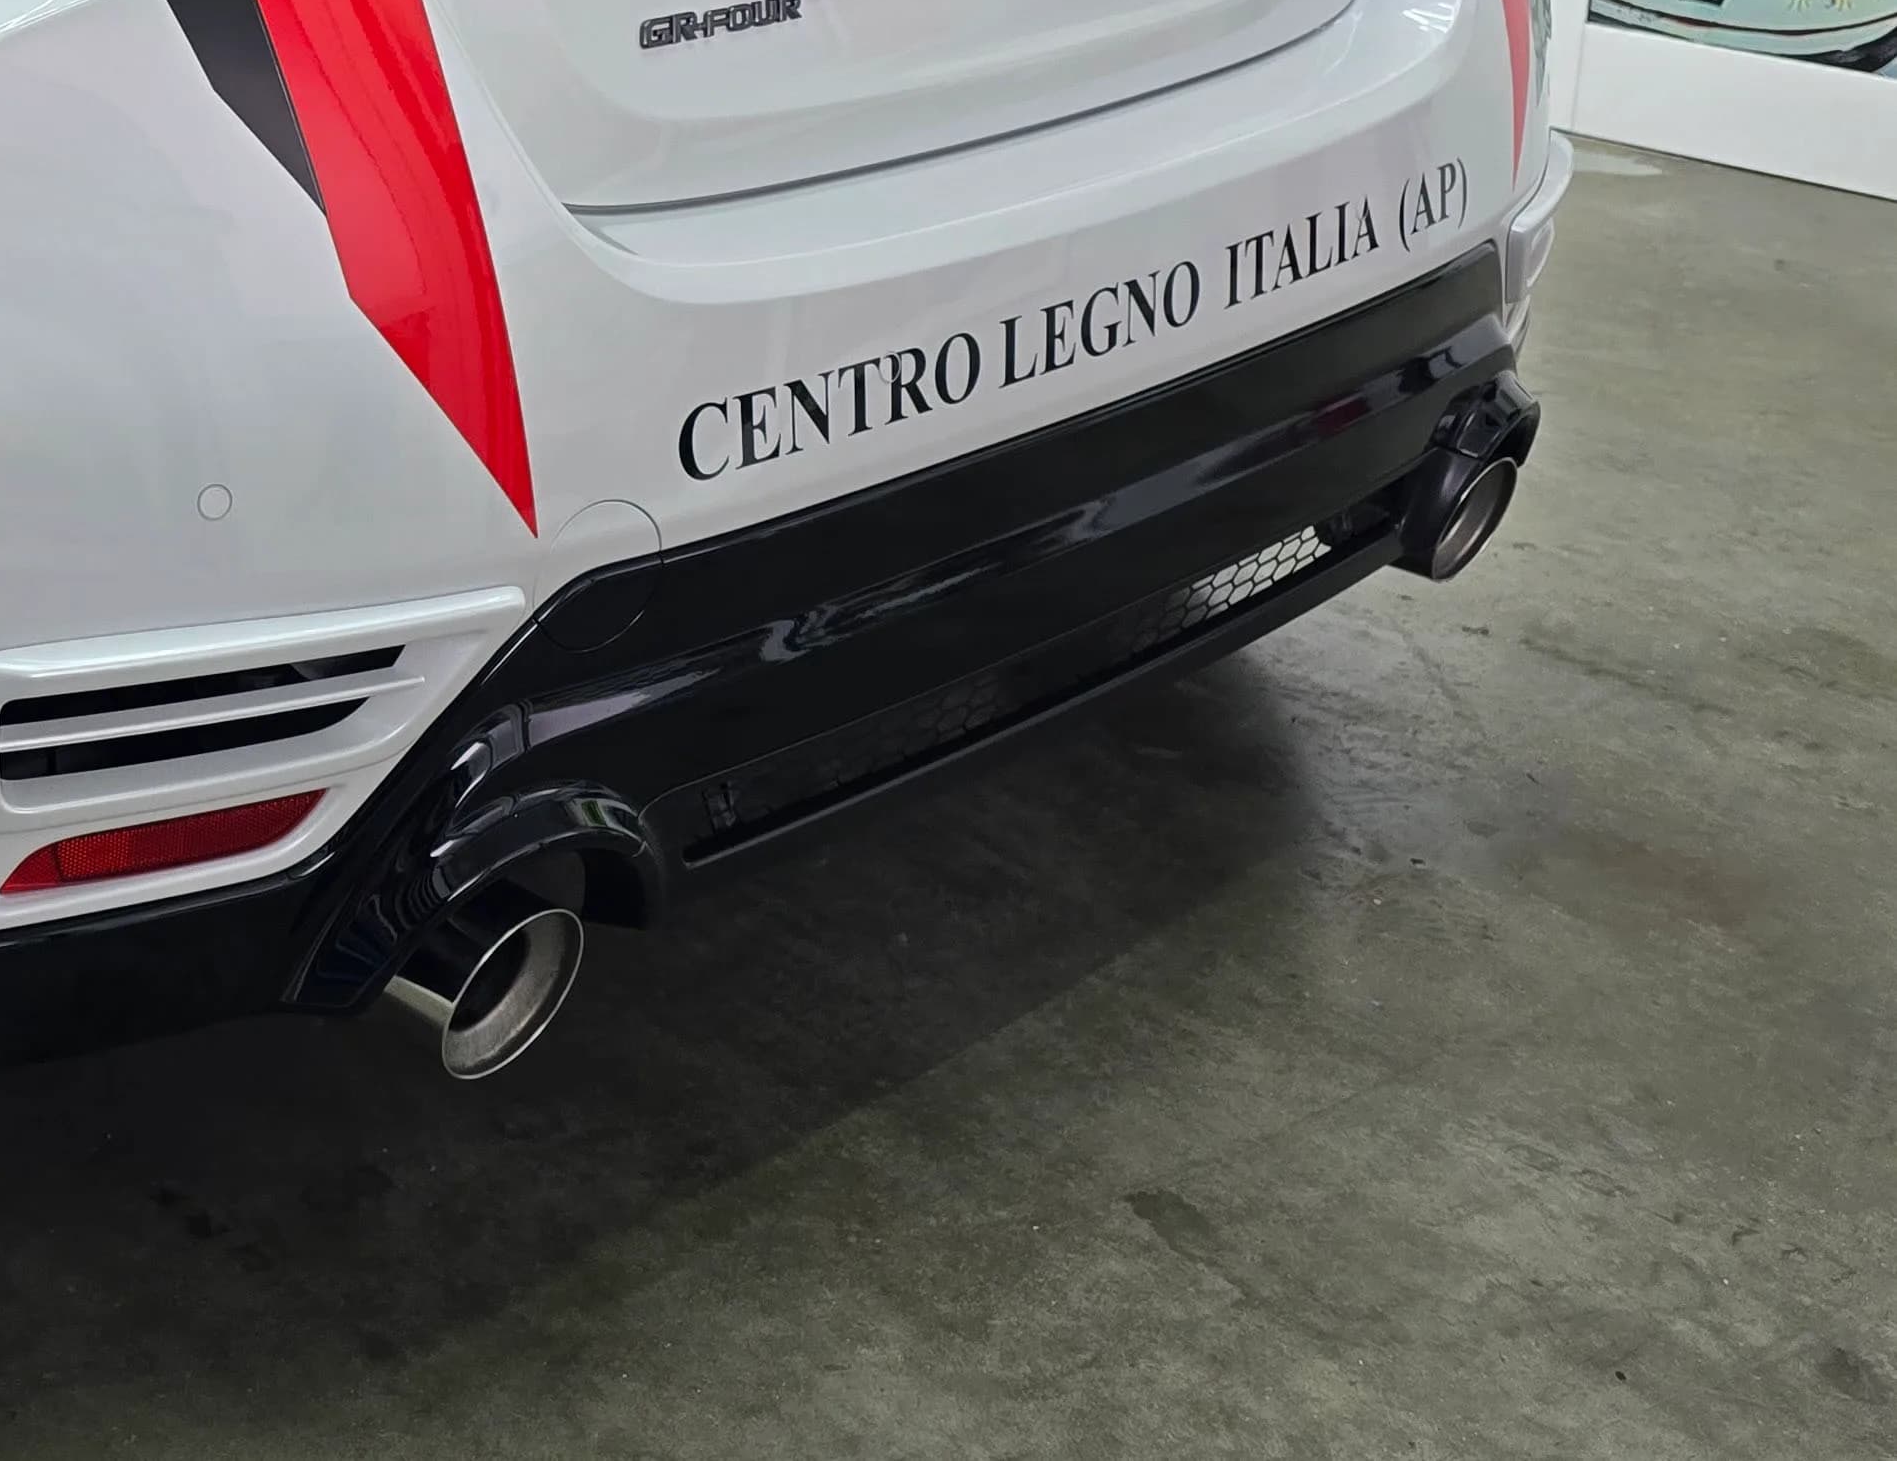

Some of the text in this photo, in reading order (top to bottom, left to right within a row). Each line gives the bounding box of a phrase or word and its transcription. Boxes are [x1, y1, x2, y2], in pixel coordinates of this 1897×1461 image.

[677, 157, 1469, 481] CENTRO LEGNO ITALIA (AP)
